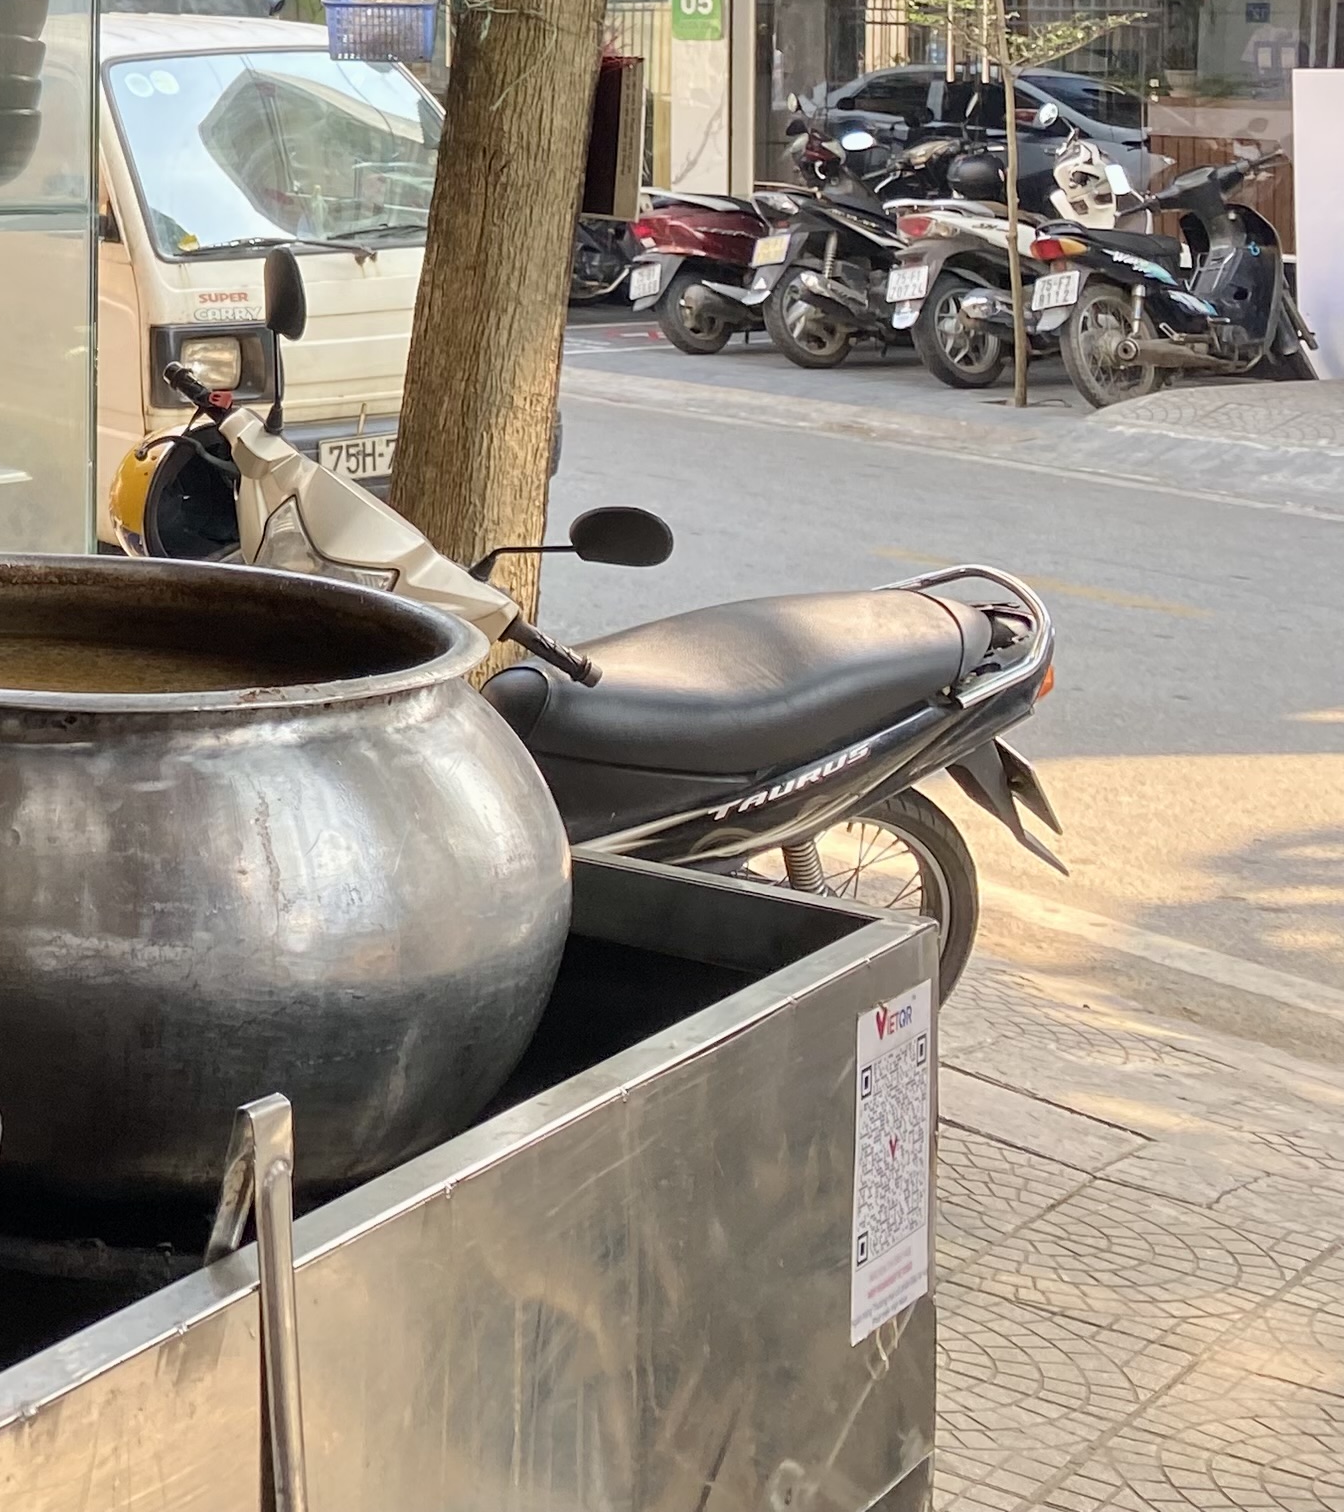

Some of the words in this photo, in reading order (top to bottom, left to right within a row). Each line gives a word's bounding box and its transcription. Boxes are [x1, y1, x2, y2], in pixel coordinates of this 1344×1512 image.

[198, 292, 249, 303] SUPER
[193, 306, 263, 322] CARRY
[708, 743, 871, 821] TAURUS
